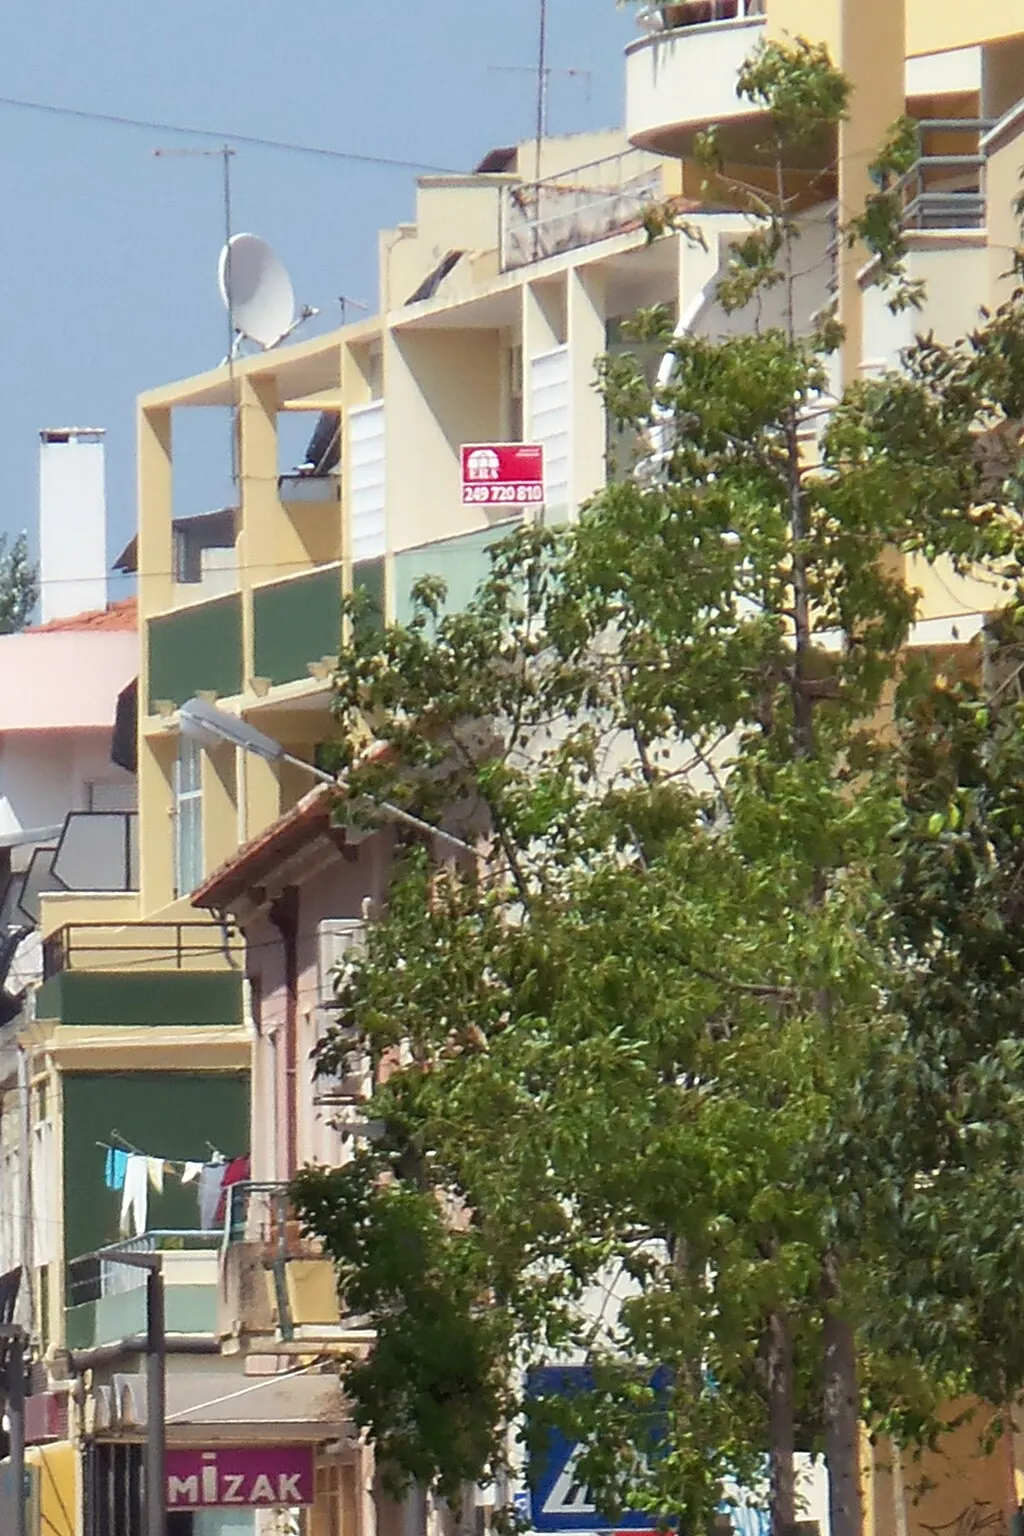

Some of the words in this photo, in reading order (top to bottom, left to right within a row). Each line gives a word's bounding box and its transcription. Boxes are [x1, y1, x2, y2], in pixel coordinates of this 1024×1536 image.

[469, 468, 499, 480] ERA
[464, 486, 489, 501] 249
[491, 486, 515, 501] 720
[517, 485, 542, 501] 810
